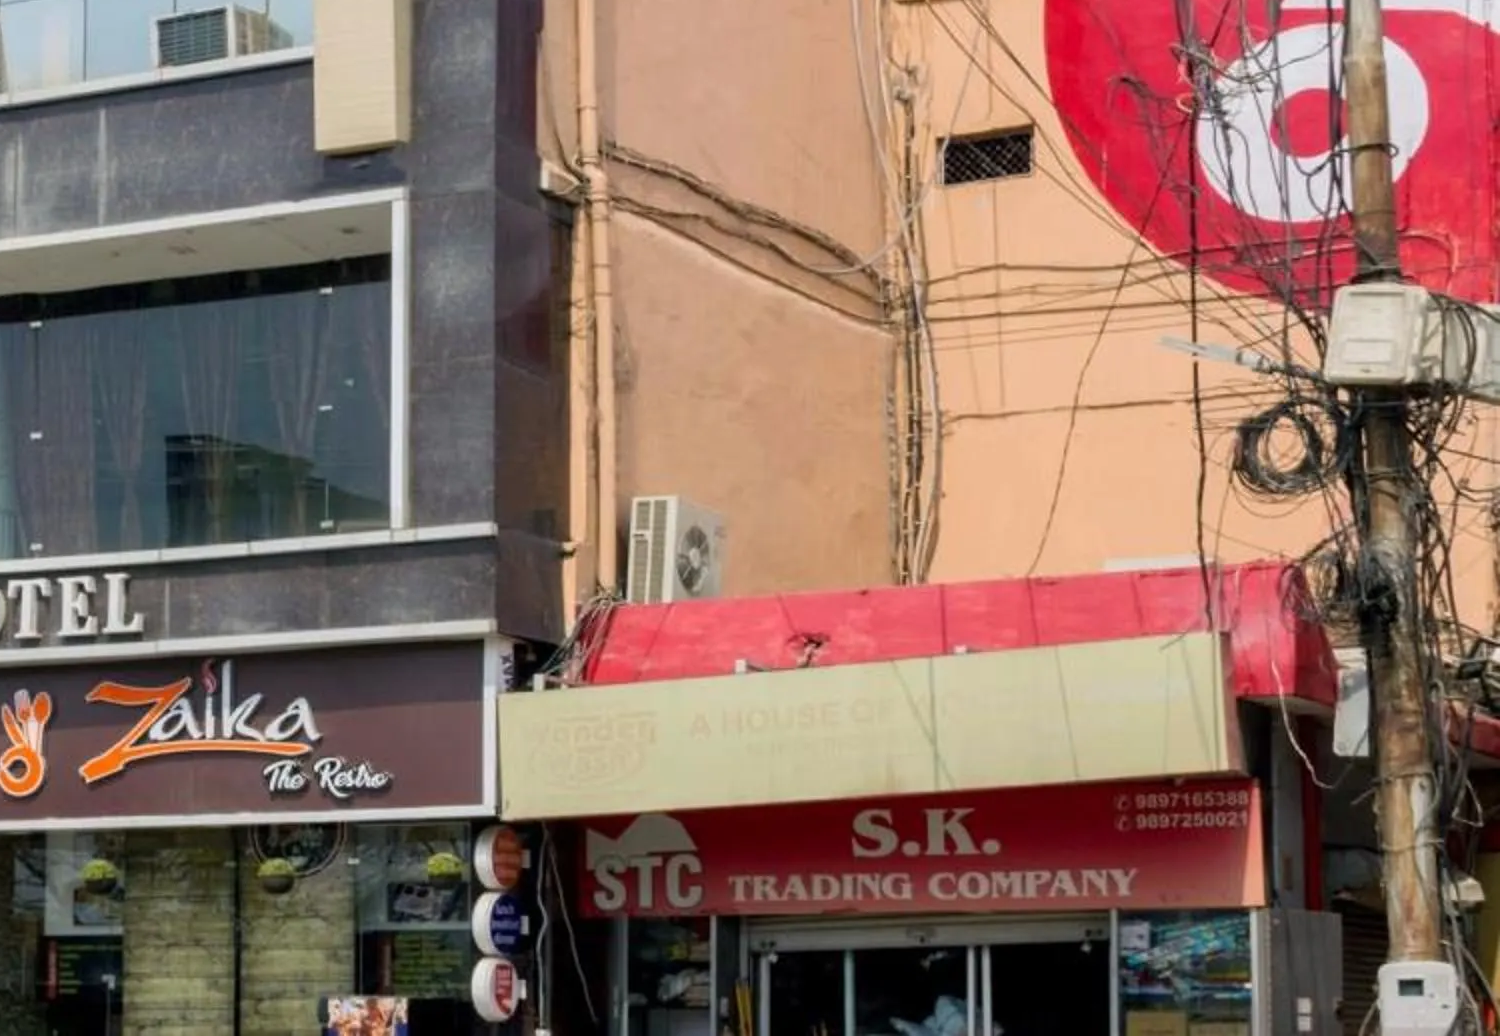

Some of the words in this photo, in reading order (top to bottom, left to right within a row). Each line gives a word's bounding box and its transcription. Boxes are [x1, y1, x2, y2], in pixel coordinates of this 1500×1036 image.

[79, 660, 324, 784] Zaika
[263, 759, 311, 792] The
[314, 756, 395, 798] Restro
[594, 852, 704, 912] STC
[729, 872, 913, 903] TRADING
[927, 868, 1139, 901] COMPANY
